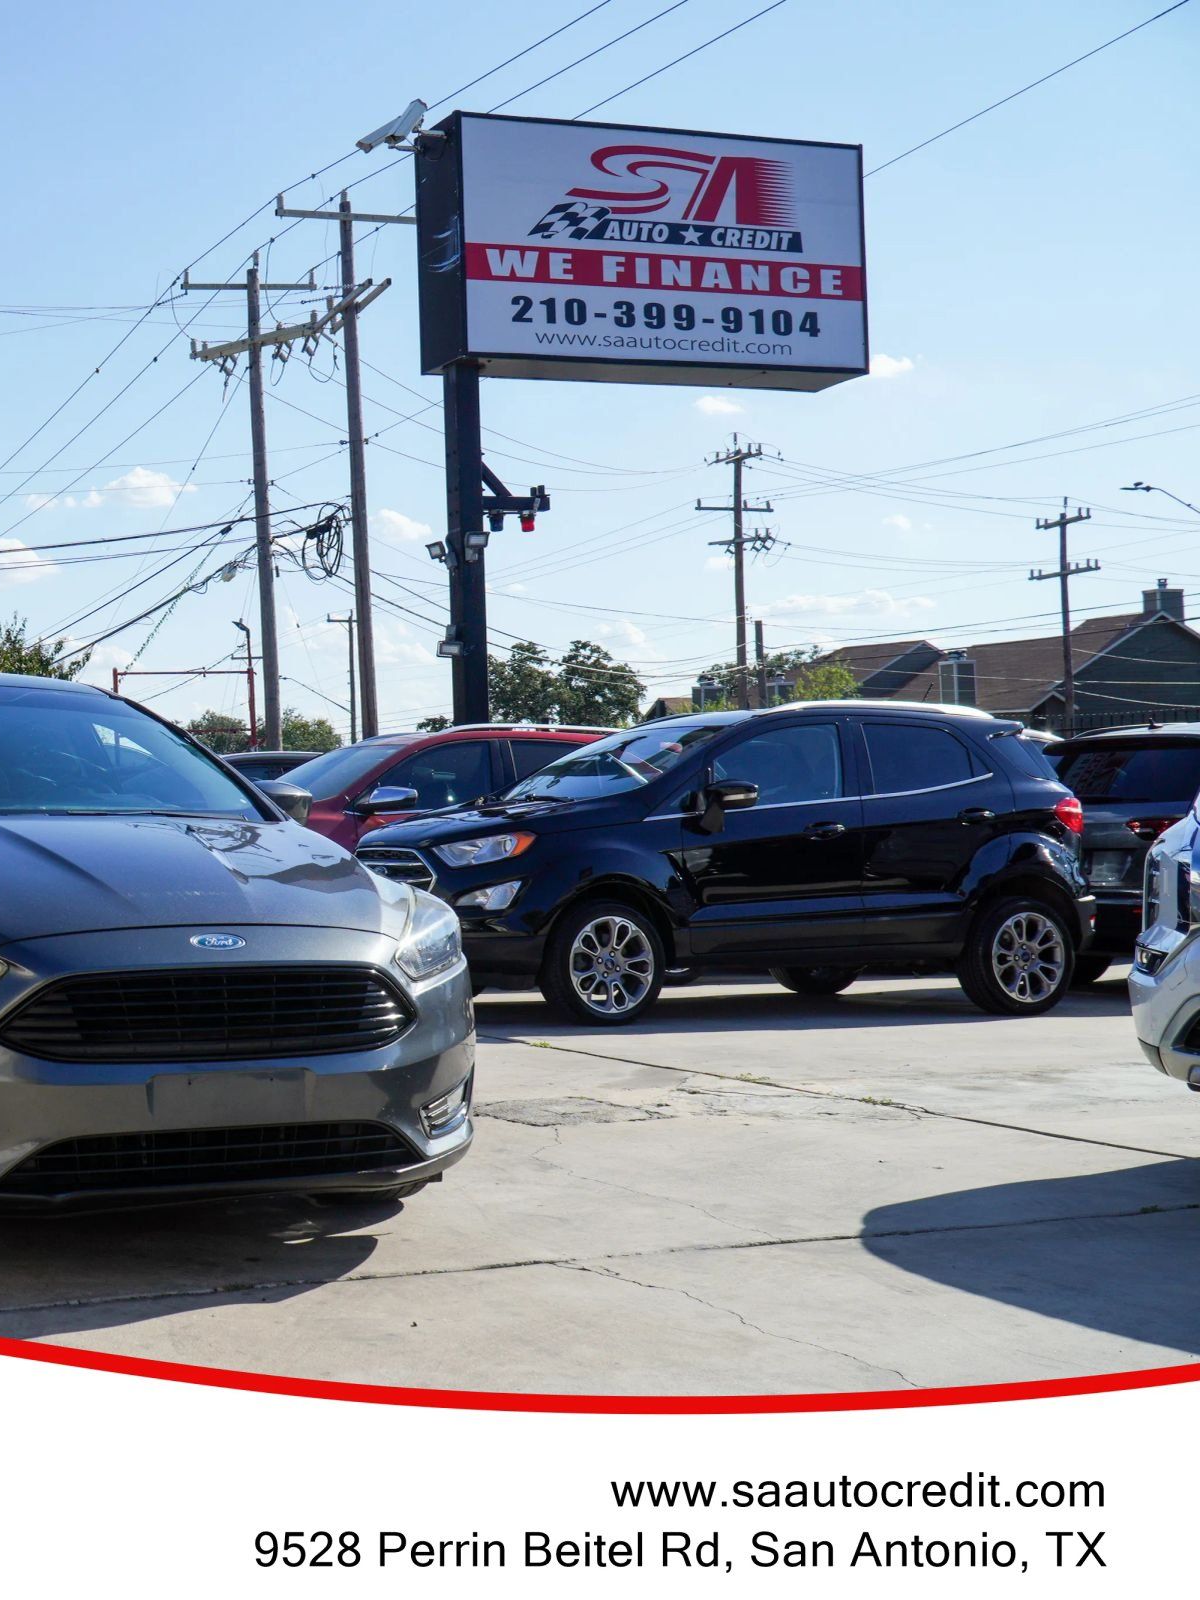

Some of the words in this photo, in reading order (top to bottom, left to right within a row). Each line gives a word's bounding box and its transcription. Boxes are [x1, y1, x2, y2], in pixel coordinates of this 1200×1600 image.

[565, 145, 799, 228] SA
[603, 218, 669, 243] AUTO
[710, 227, 794, 252] CREDIT
[486, 248, 574, 281] WE
[602, 255, 844, 297] FINANCE
[511, 295, 821, 338] 210-399-9104
[535, 331, 793, 356] www.saautocredit.com
[204, 936, 234, 946] Ford
